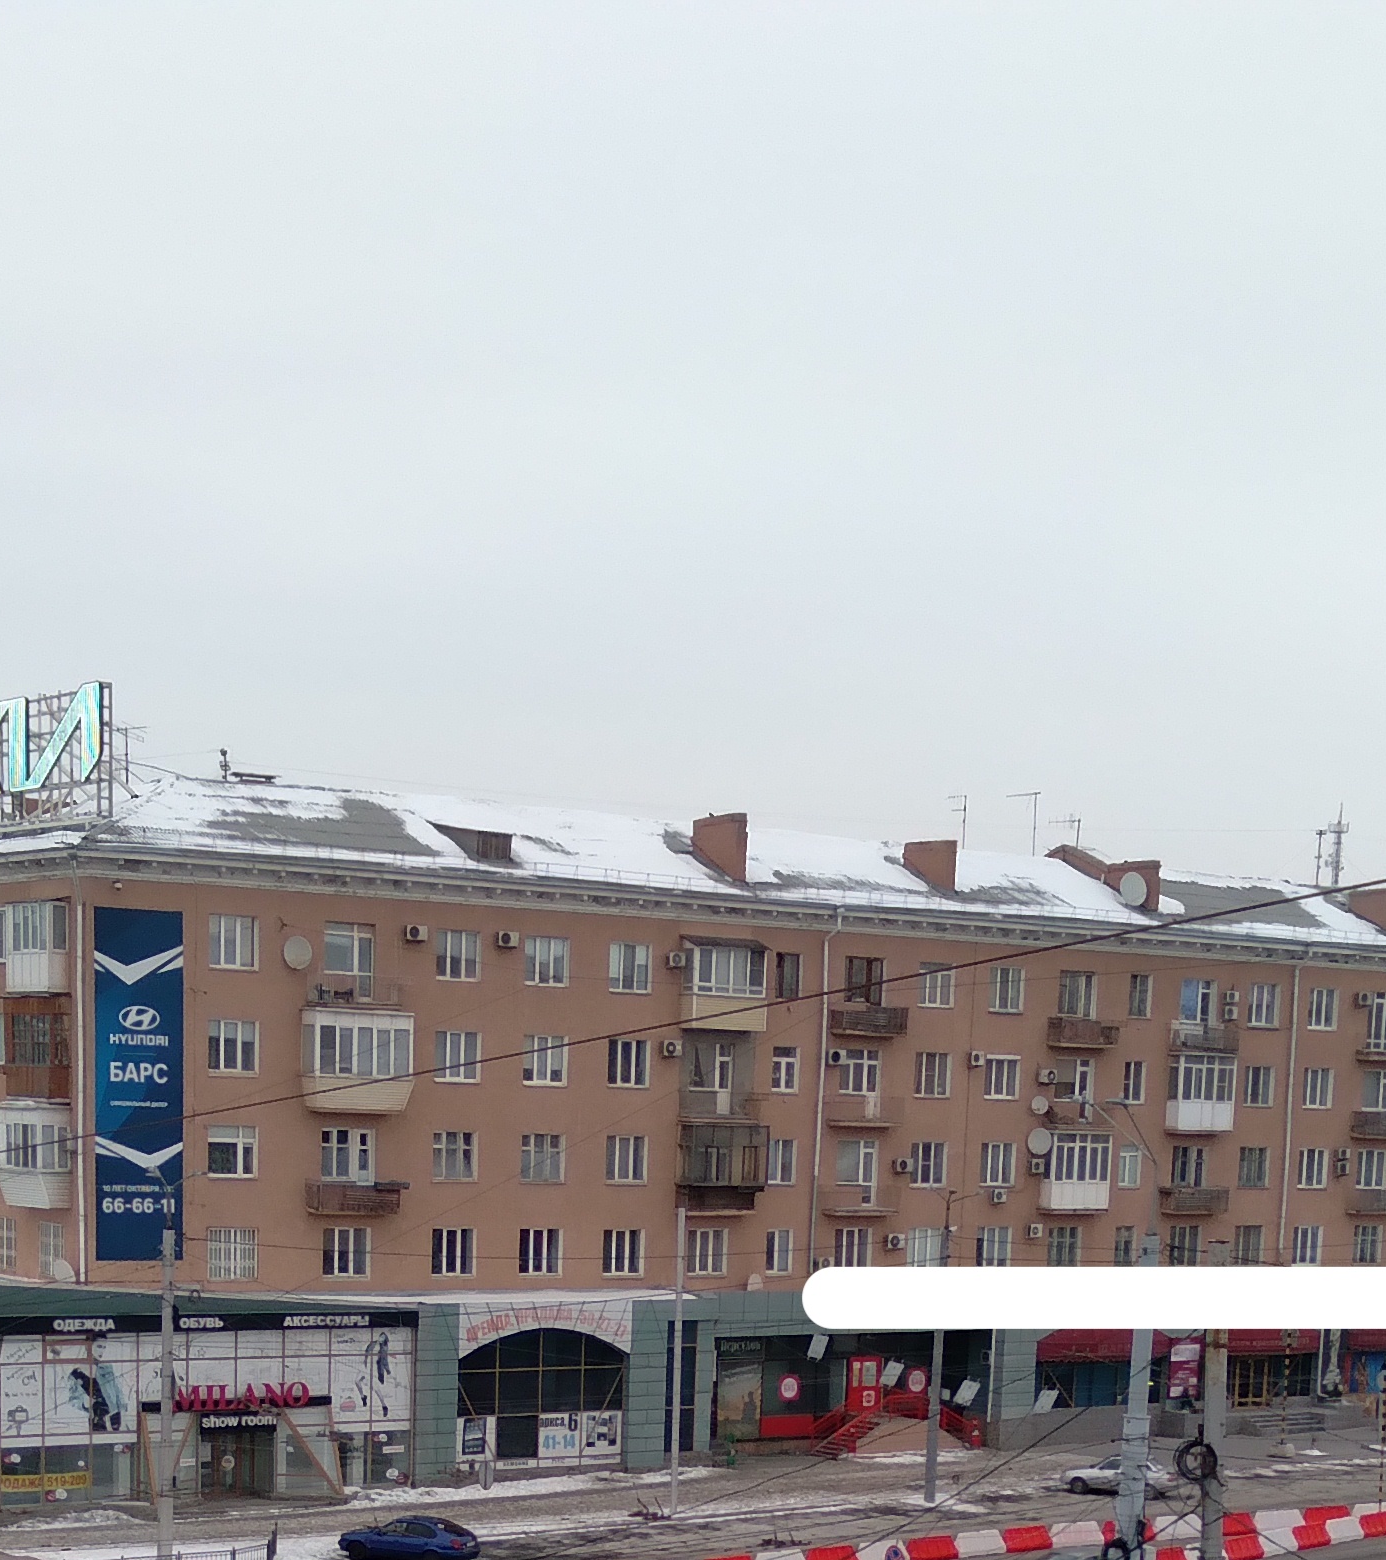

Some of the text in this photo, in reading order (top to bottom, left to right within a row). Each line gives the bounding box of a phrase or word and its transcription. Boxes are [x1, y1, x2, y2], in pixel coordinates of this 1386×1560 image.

[109, 1033, 168, 1047] HYUNDAI
[110, 1061, 169, 1084] БАРС
[102, 1197, 175, 1214] 66-66-11
[53, 1315, 370, 1332] ОДЕЖДА ОБУВЬ АКСЕССУАРЫ
[173, 1381, 311, 1414] MILANO
[201, 1415, 277, 1429] show room
[568, 1412, 579, 1432] 6
[542, 1433, 576, 1450] 41-14
